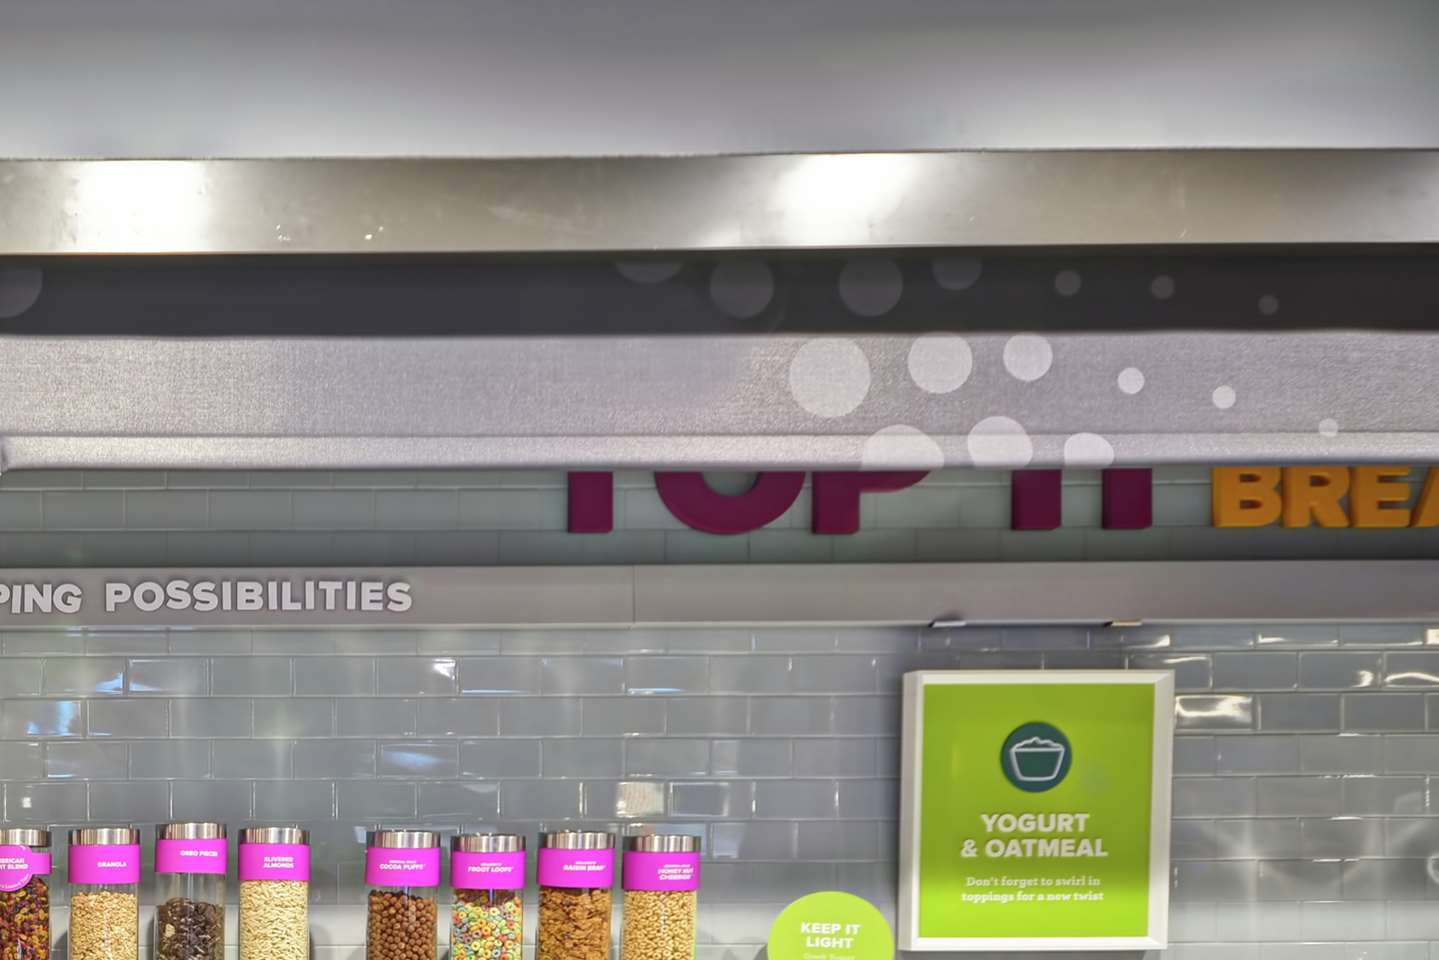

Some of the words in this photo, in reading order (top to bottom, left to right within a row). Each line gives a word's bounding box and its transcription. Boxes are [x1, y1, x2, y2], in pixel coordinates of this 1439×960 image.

[105, 579, 412, 612] POSSIBILITIES
[980, 813, 1090, 832] YOGURT
[960, 838, 978, 857] &
[985, 838, 1108, 857] OATMEAL
[965, 876, 998, 886] Don't
[1000, 876, 1038, 888] forget
[1041, 878, 1053, 886] to
[1055, 876, 1085, 886] swirl
[1088, 876, 1100, 886] in
[961, 892, 1014, 903] toppings
[1016, 890, 1035, 901] for
[1037, 893, 1045, 901] a
[1073, 890, 1105, 901] twist
[800, 922, 841, 934] KEEP
[845, 923, 861, 936] IT
[805, 936, 854, 949] LIGHT
